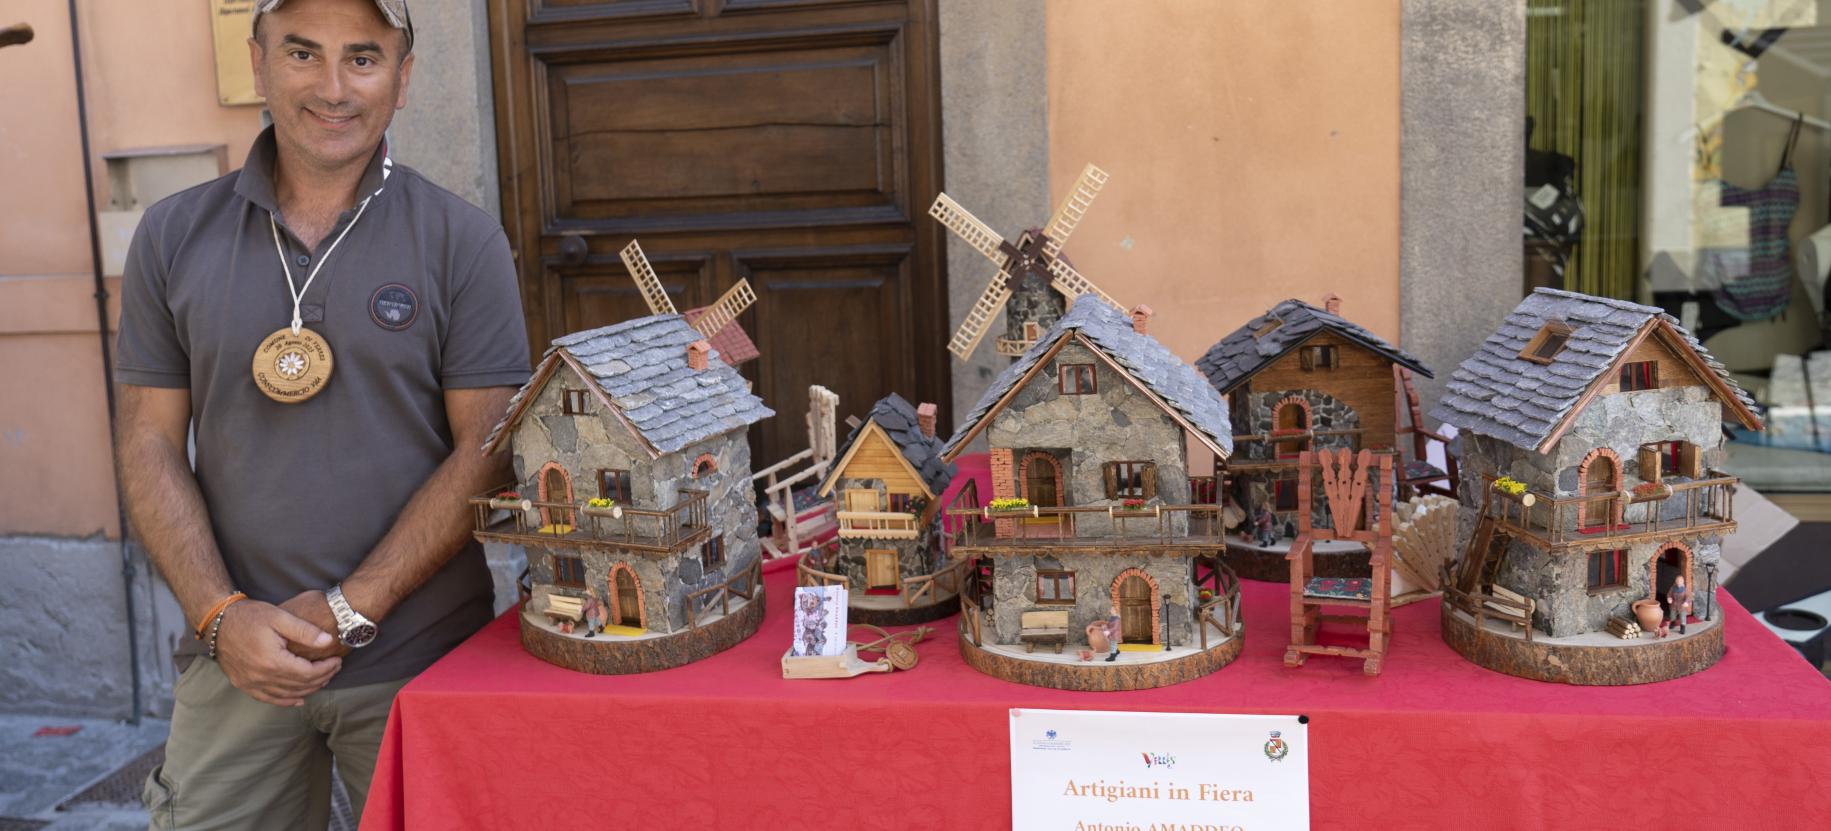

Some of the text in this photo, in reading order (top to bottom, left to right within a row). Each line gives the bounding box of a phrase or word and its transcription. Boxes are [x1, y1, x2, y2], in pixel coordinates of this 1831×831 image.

[264, 335, 286, 353] COMUNE
[258, 372, 310, 397] CONFCOMMERCIO
[1064, 779, 1254, 803] Artigiani in Fiera
[1074, 820, 1141, 831] Antonio
